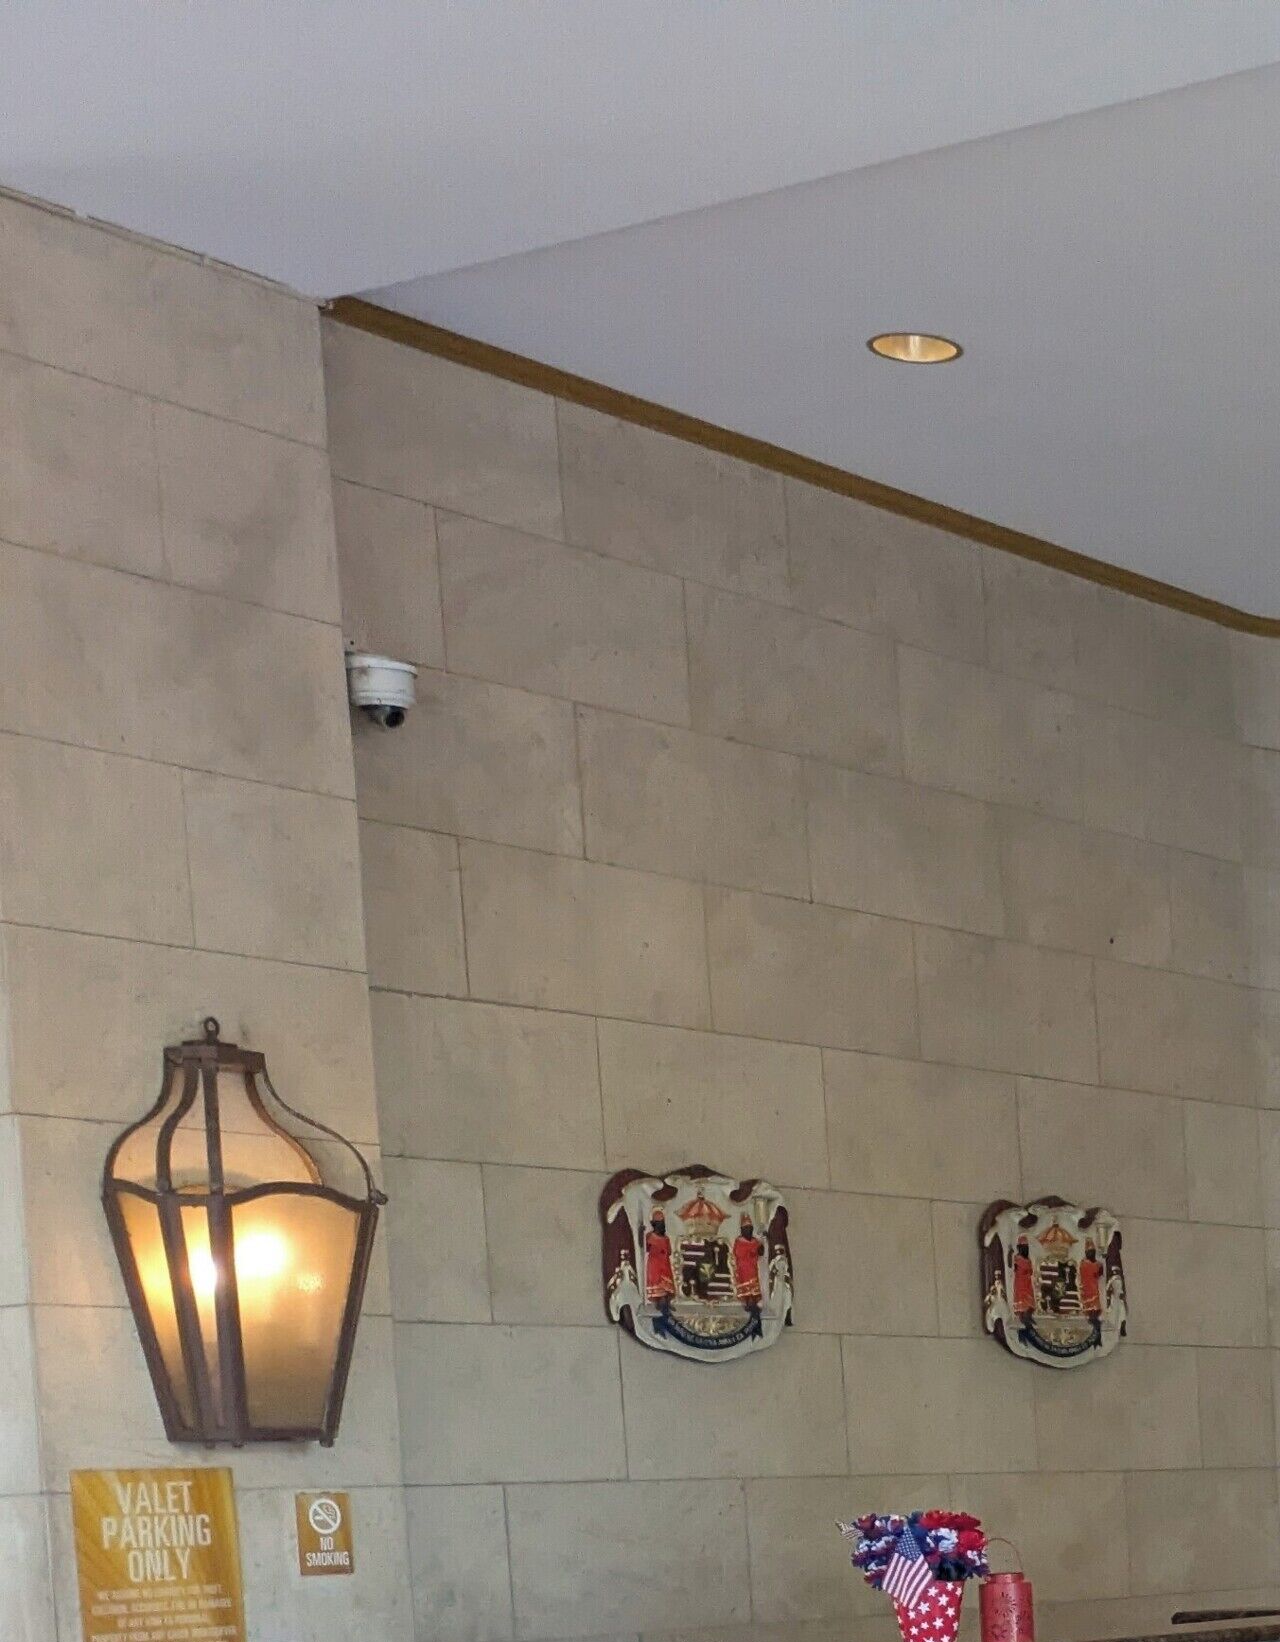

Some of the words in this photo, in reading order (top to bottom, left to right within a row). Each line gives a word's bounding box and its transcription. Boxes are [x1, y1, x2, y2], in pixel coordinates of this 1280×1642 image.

[114, 1480, 193, 1515] VALET
[101, 1513, 212, 1550] PARKING
[319, 1536, 334, 1551] NO
[128, 1549, 192, 1583] ONLY
[305, 1551, 350, 1567] SMOKING
